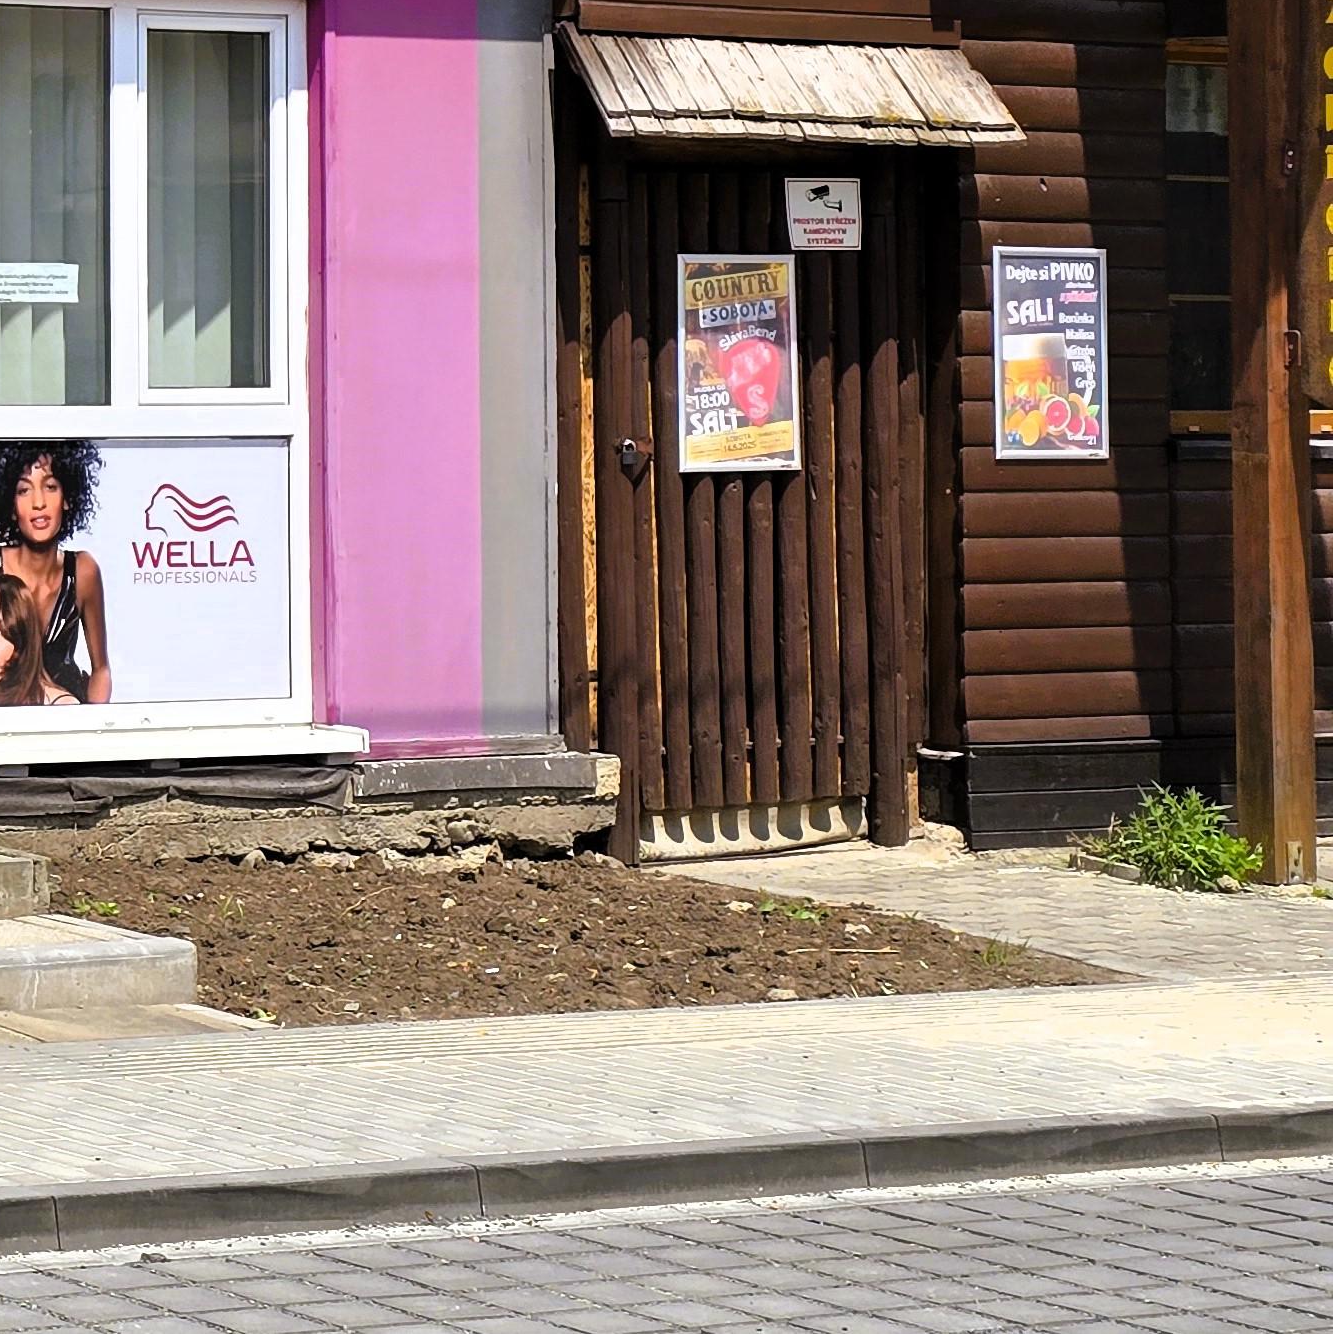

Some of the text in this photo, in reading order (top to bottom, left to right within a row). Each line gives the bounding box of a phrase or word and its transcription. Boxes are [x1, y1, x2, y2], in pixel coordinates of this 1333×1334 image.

[1005, 264, 1038, 283] Dejte
[1050, 262, 1094, 281] PIVKO
[691, 270, 781, 302] COUNTRY
[709, 301, 768, 322] SOBOTA
[692, 391, 730, 410] 18:00
[131, 540, 255, 568] WELLA
[133, 570, 257, 584] PROFESSIONALS
